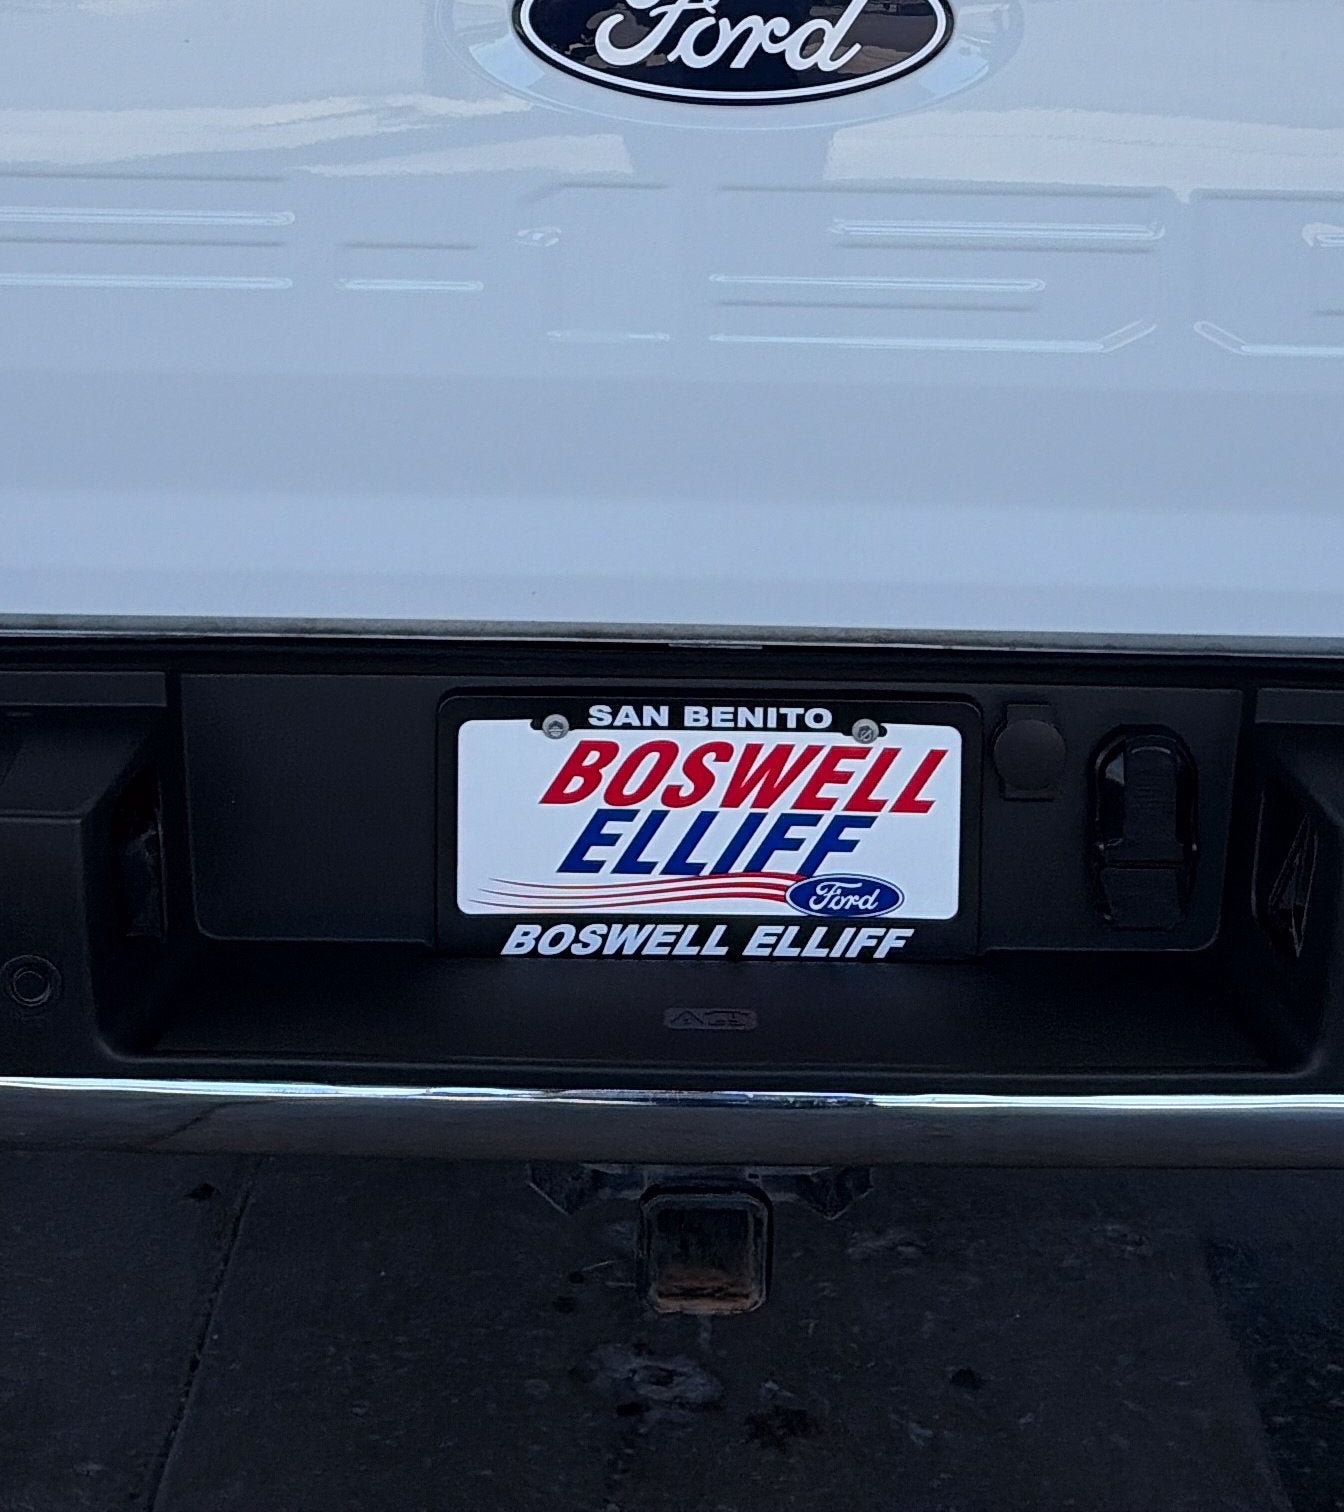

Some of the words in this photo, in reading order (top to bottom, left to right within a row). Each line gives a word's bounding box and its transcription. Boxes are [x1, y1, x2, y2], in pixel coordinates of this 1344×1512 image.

[588, 704, 669, 728] SAN
[684, 706, 833, 729] BENITO
[539, 740, 948, 814] BOSWELL
[556, 808, 878, 876] ELLIFF
[809, 881, 880, 911] Ford
[500, 924, 729, 956] BOSWELL
[741, 925, 915, 959] ELLIFF
